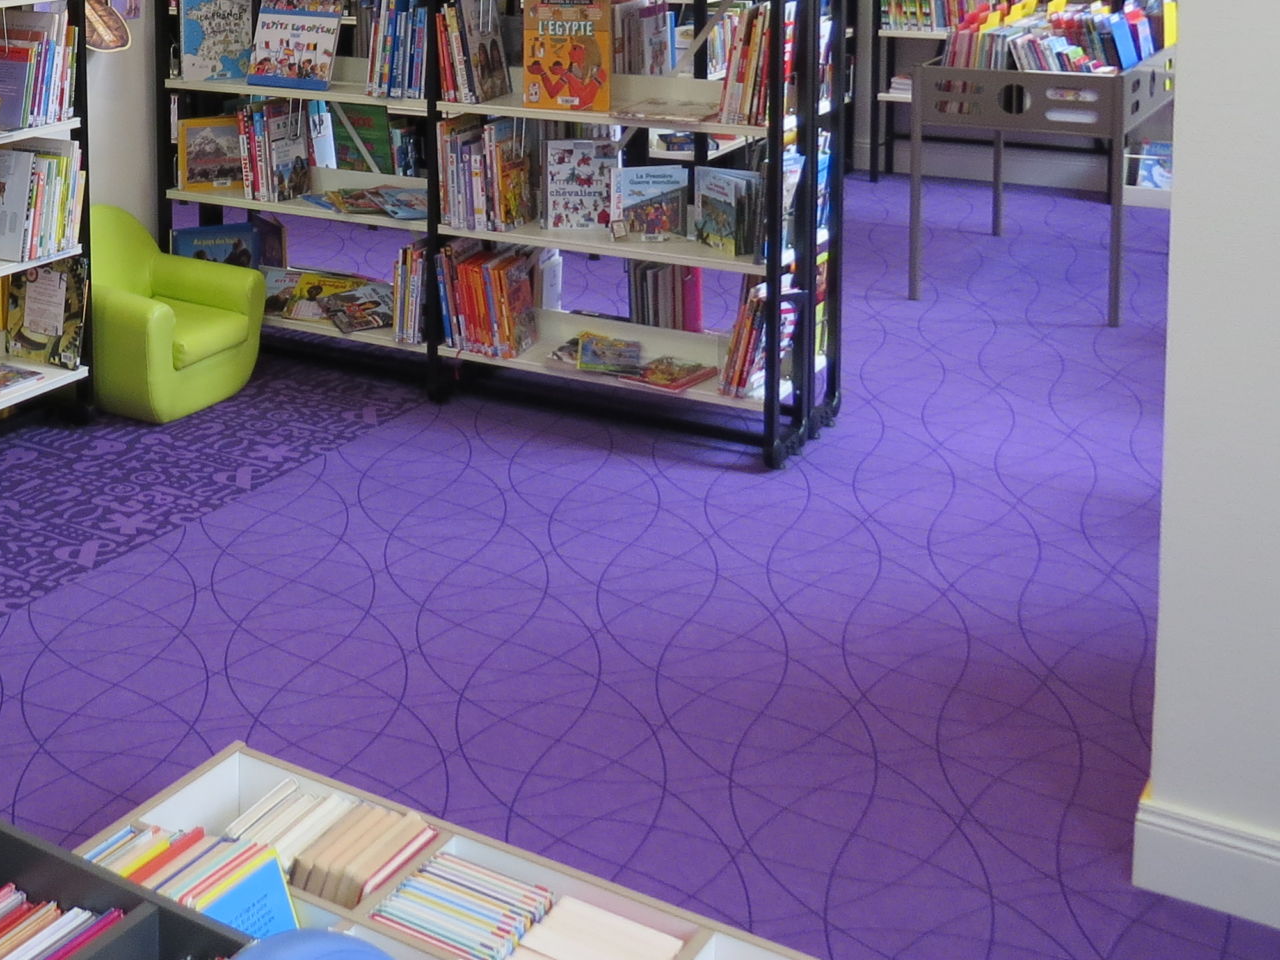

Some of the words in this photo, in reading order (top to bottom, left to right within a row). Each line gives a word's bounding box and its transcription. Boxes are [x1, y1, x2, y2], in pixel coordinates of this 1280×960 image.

[261, 19, 289, 31] PETITS
[538, 19, 593, 36] L'ÉGYPTE
[240, 155, 251, 188] CHINE
[629, 178, 650, 186] Guerre
[651, 178, 681, 186] mondiale
[549, 189, 604, 198] chevaliers
